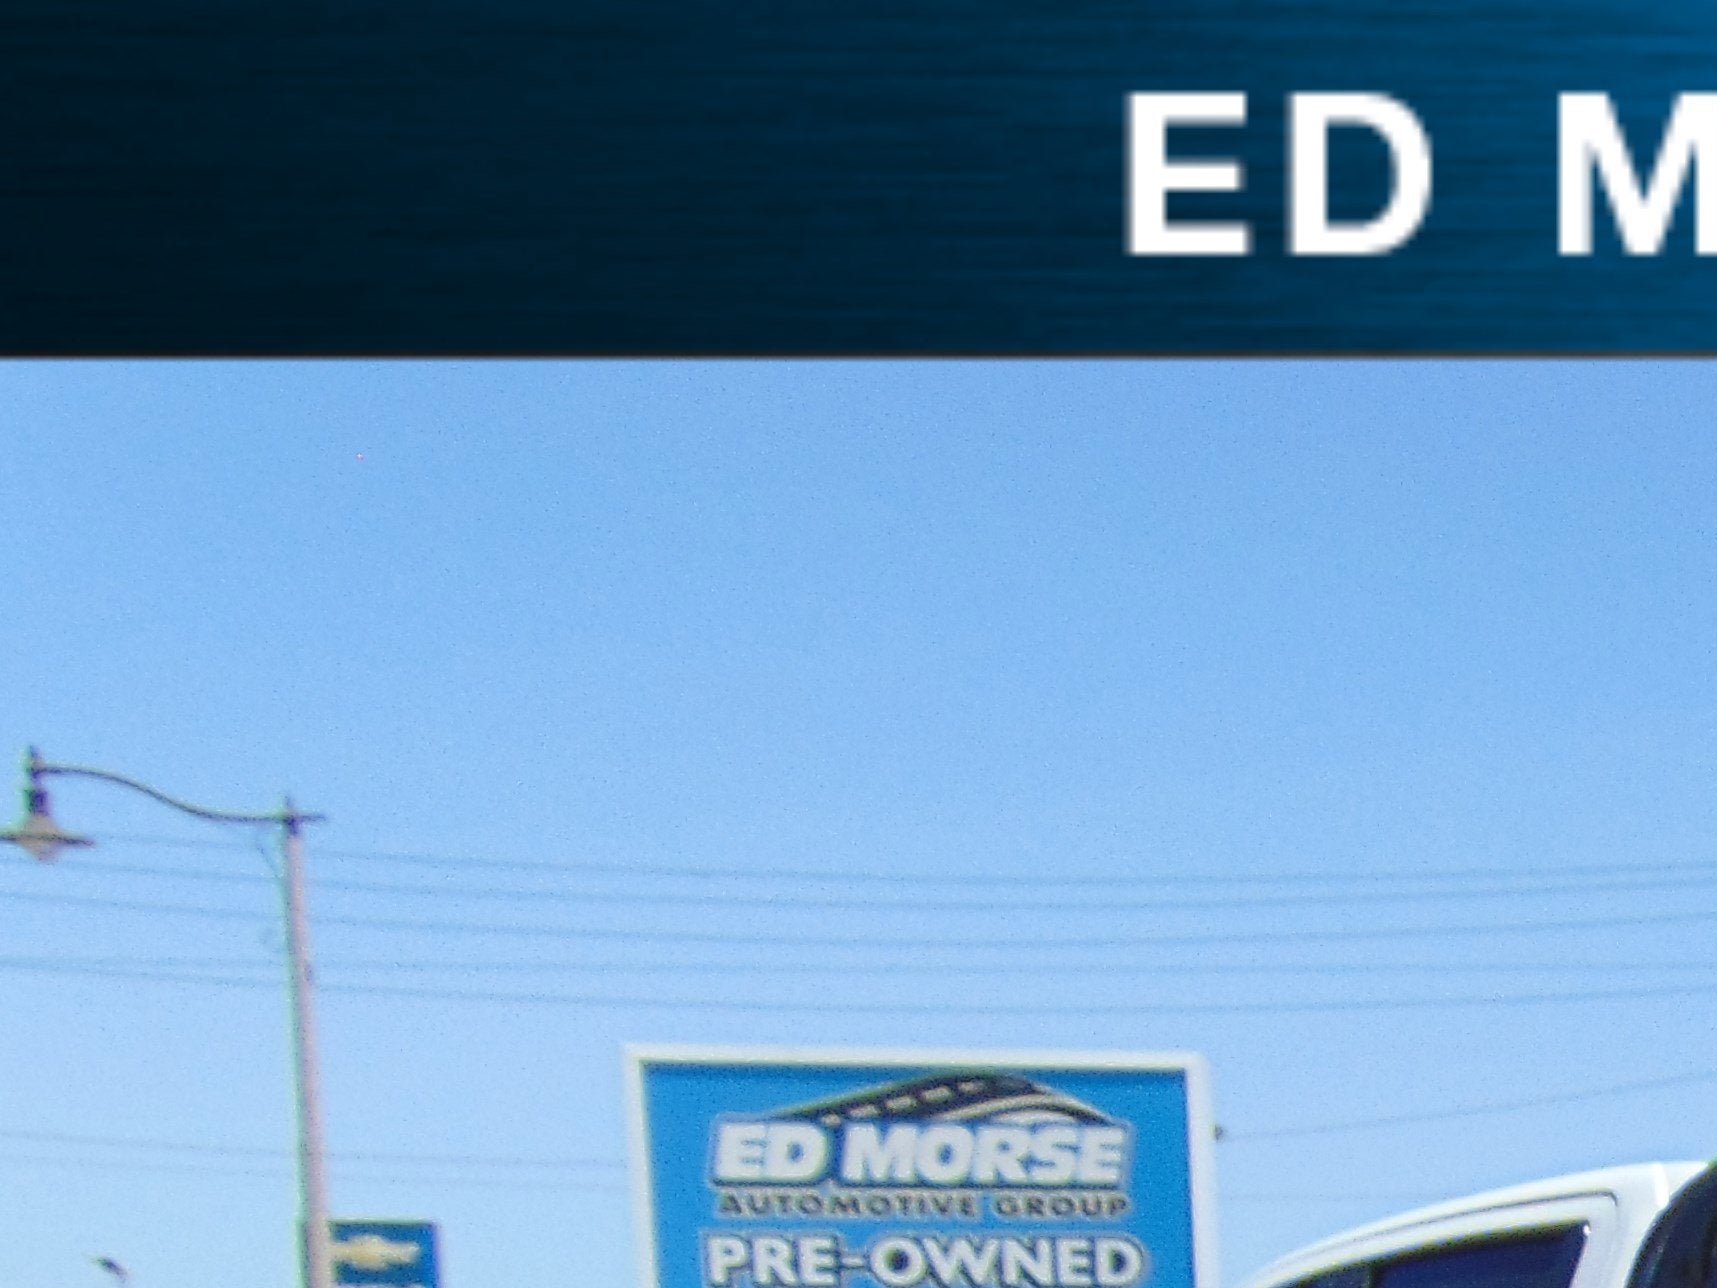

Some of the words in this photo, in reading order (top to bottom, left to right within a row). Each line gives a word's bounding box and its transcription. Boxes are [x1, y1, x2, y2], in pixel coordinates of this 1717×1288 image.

[714, 1121, 829, 1184] ED
[842, 1121, 1128, 1187] MORSE
[718, 1193, 978, 1218] AUTOMOTIVE
[992, 1195, 1128, 1218] GROUP
[707, 1234, 1146, 1288] PRE-OWNED
